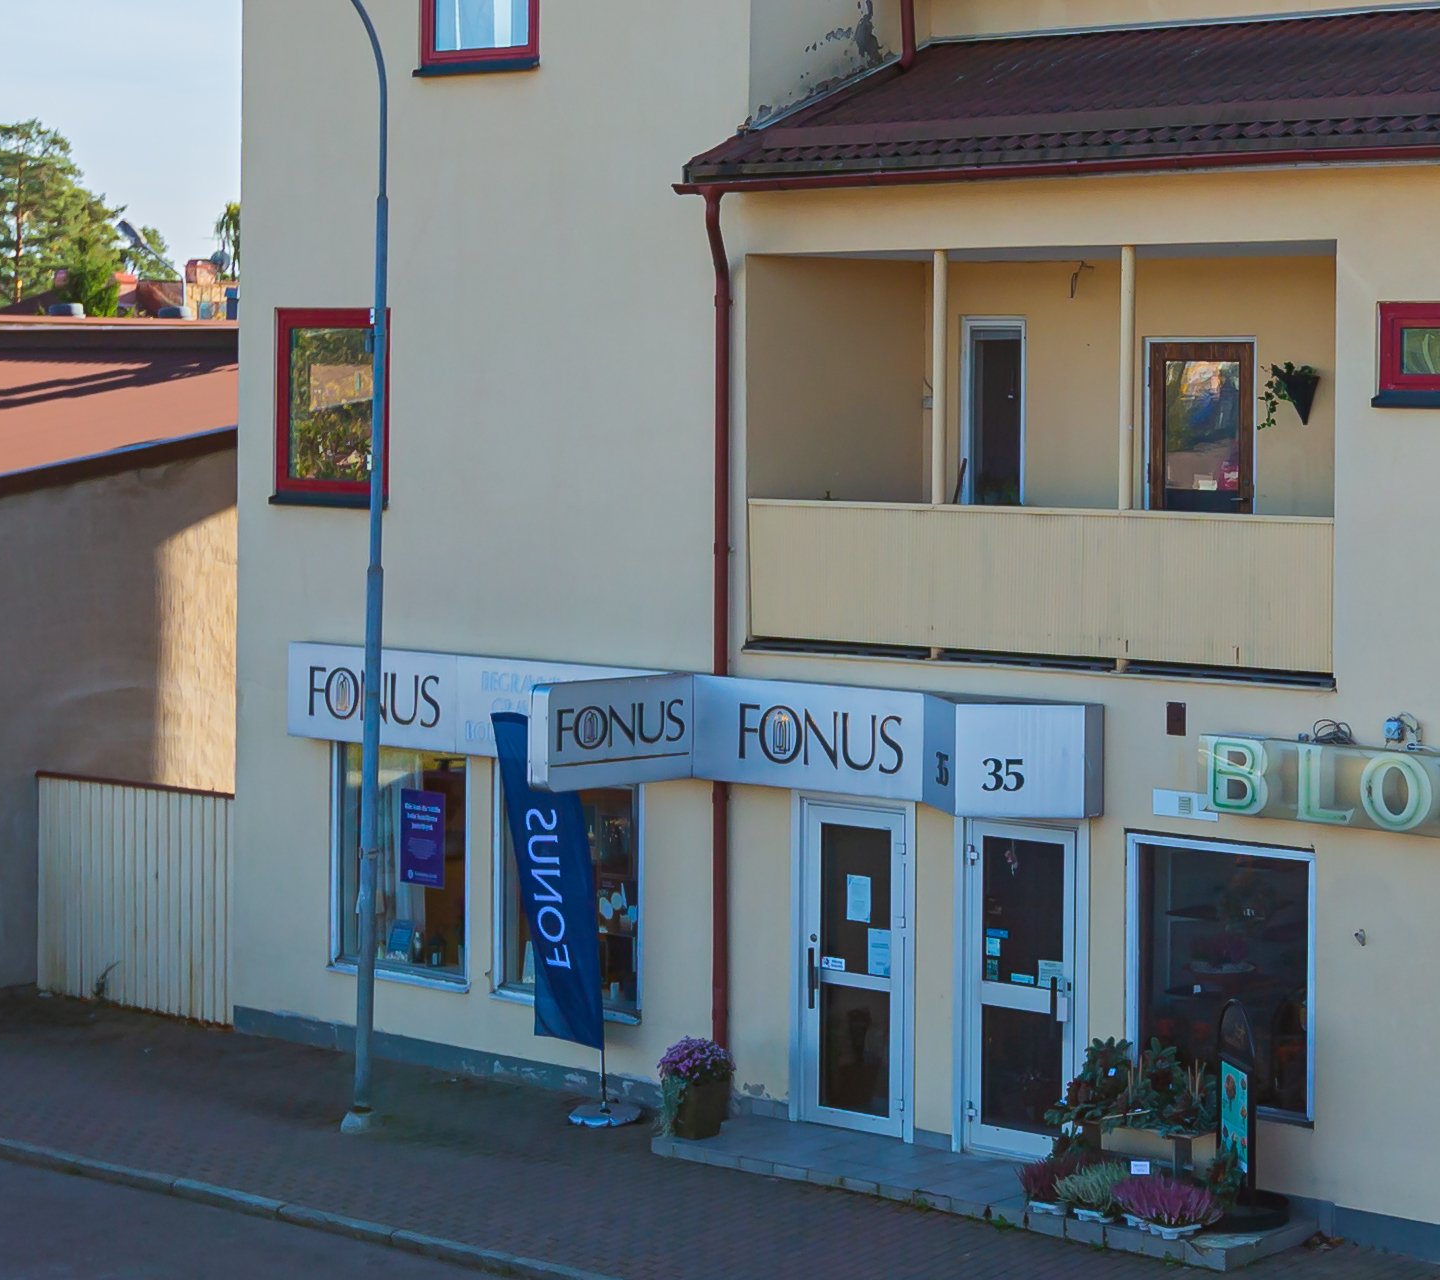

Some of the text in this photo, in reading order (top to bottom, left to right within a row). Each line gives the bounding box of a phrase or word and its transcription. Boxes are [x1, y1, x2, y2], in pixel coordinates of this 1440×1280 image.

[556, 698, 685, 752] FONUS
[739, 703, 904, 775] FONUS
[981, 758, 1025, 792] 35
